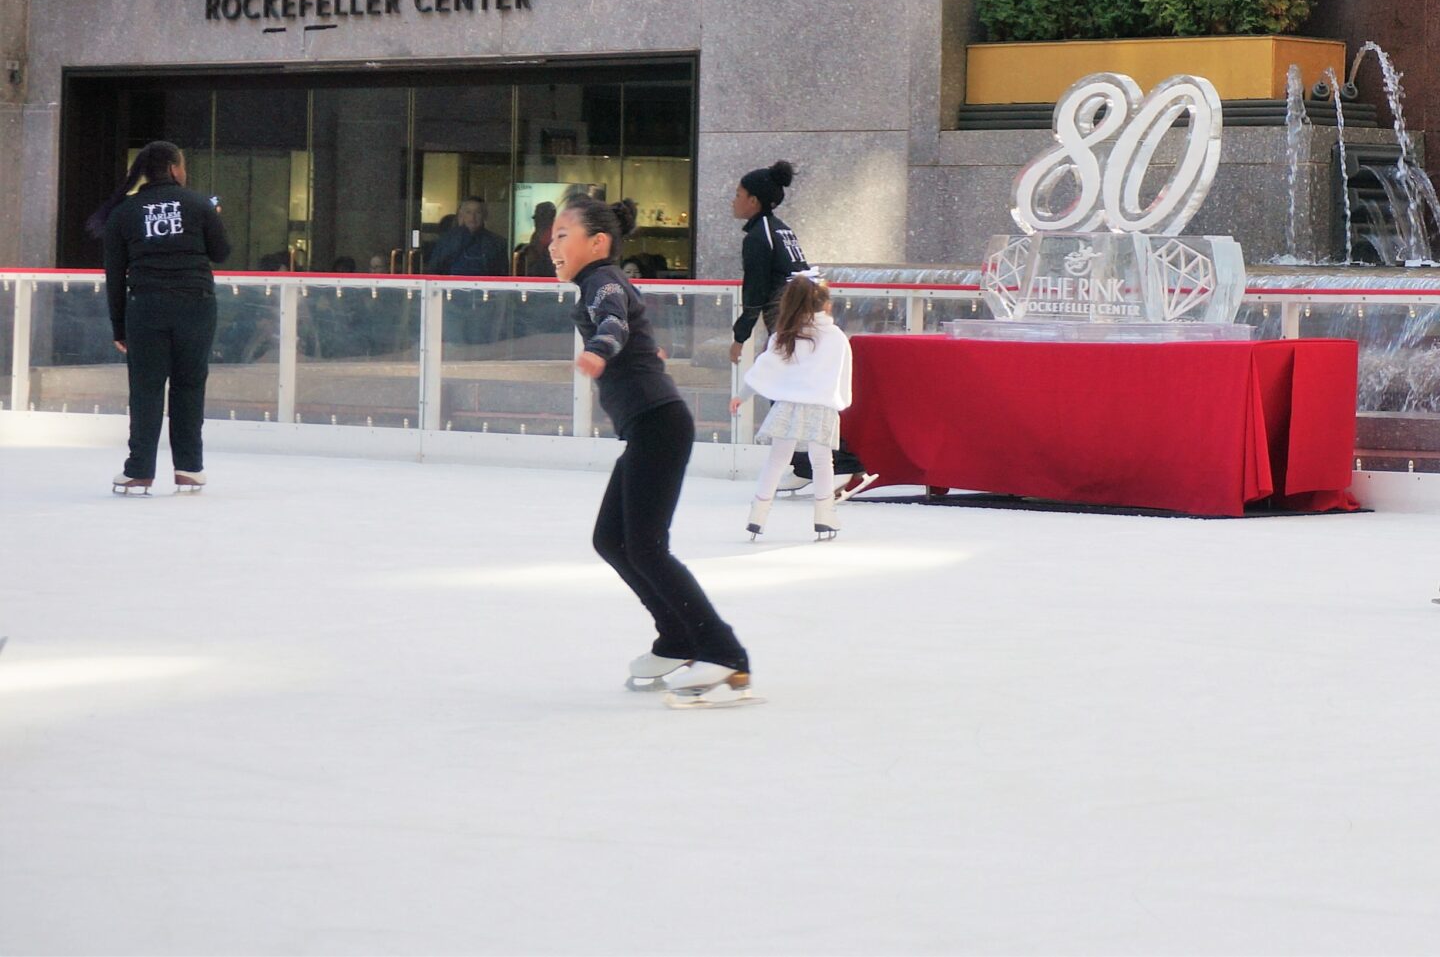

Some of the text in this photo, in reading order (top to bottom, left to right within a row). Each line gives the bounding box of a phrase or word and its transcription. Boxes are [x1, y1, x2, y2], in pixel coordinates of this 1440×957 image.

[1012, 76, 1216, 234] 80
[145, 211, 181, 221] HARLEM
[145, 218, 184, 237] ICE
[1035, 276, 1124, 302] THE RINK
